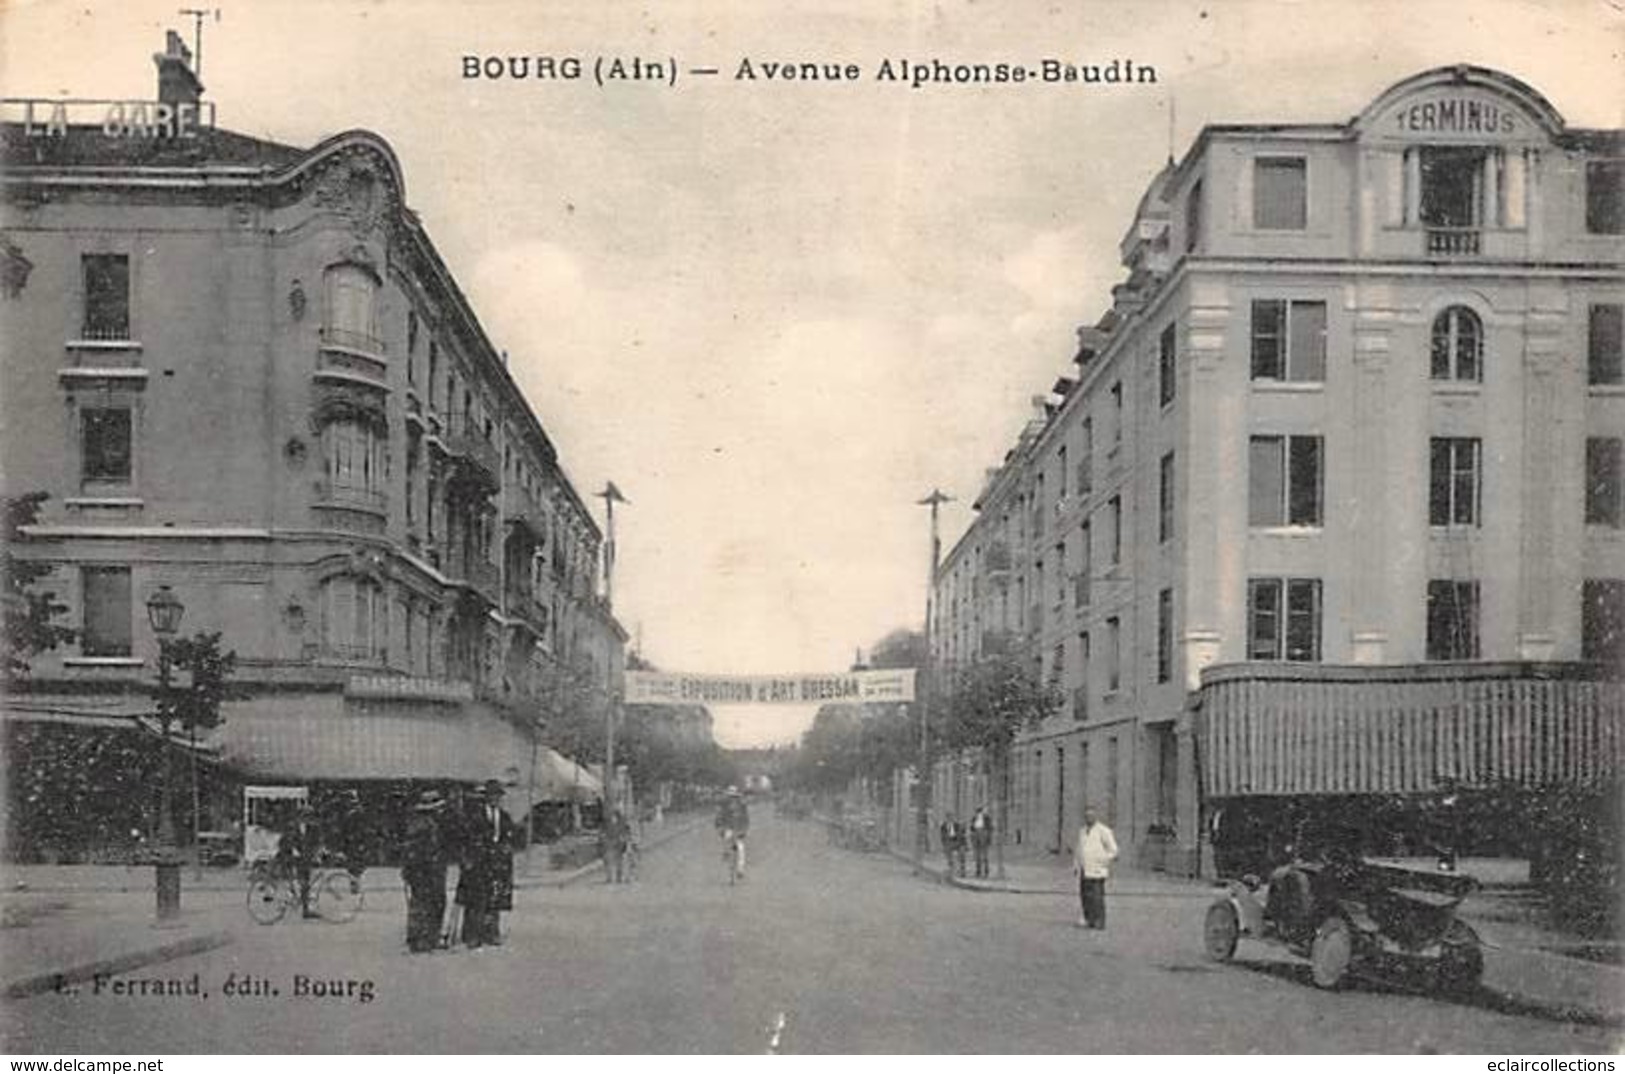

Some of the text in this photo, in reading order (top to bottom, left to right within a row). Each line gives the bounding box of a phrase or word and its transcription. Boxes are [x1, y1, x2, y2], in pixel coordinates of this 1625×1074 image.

[25, 100, 197, 138] LA GARE
[1397, 100, 1515, 133] TERMINUS
[680, 677, 752, 702] EXPOSITION
